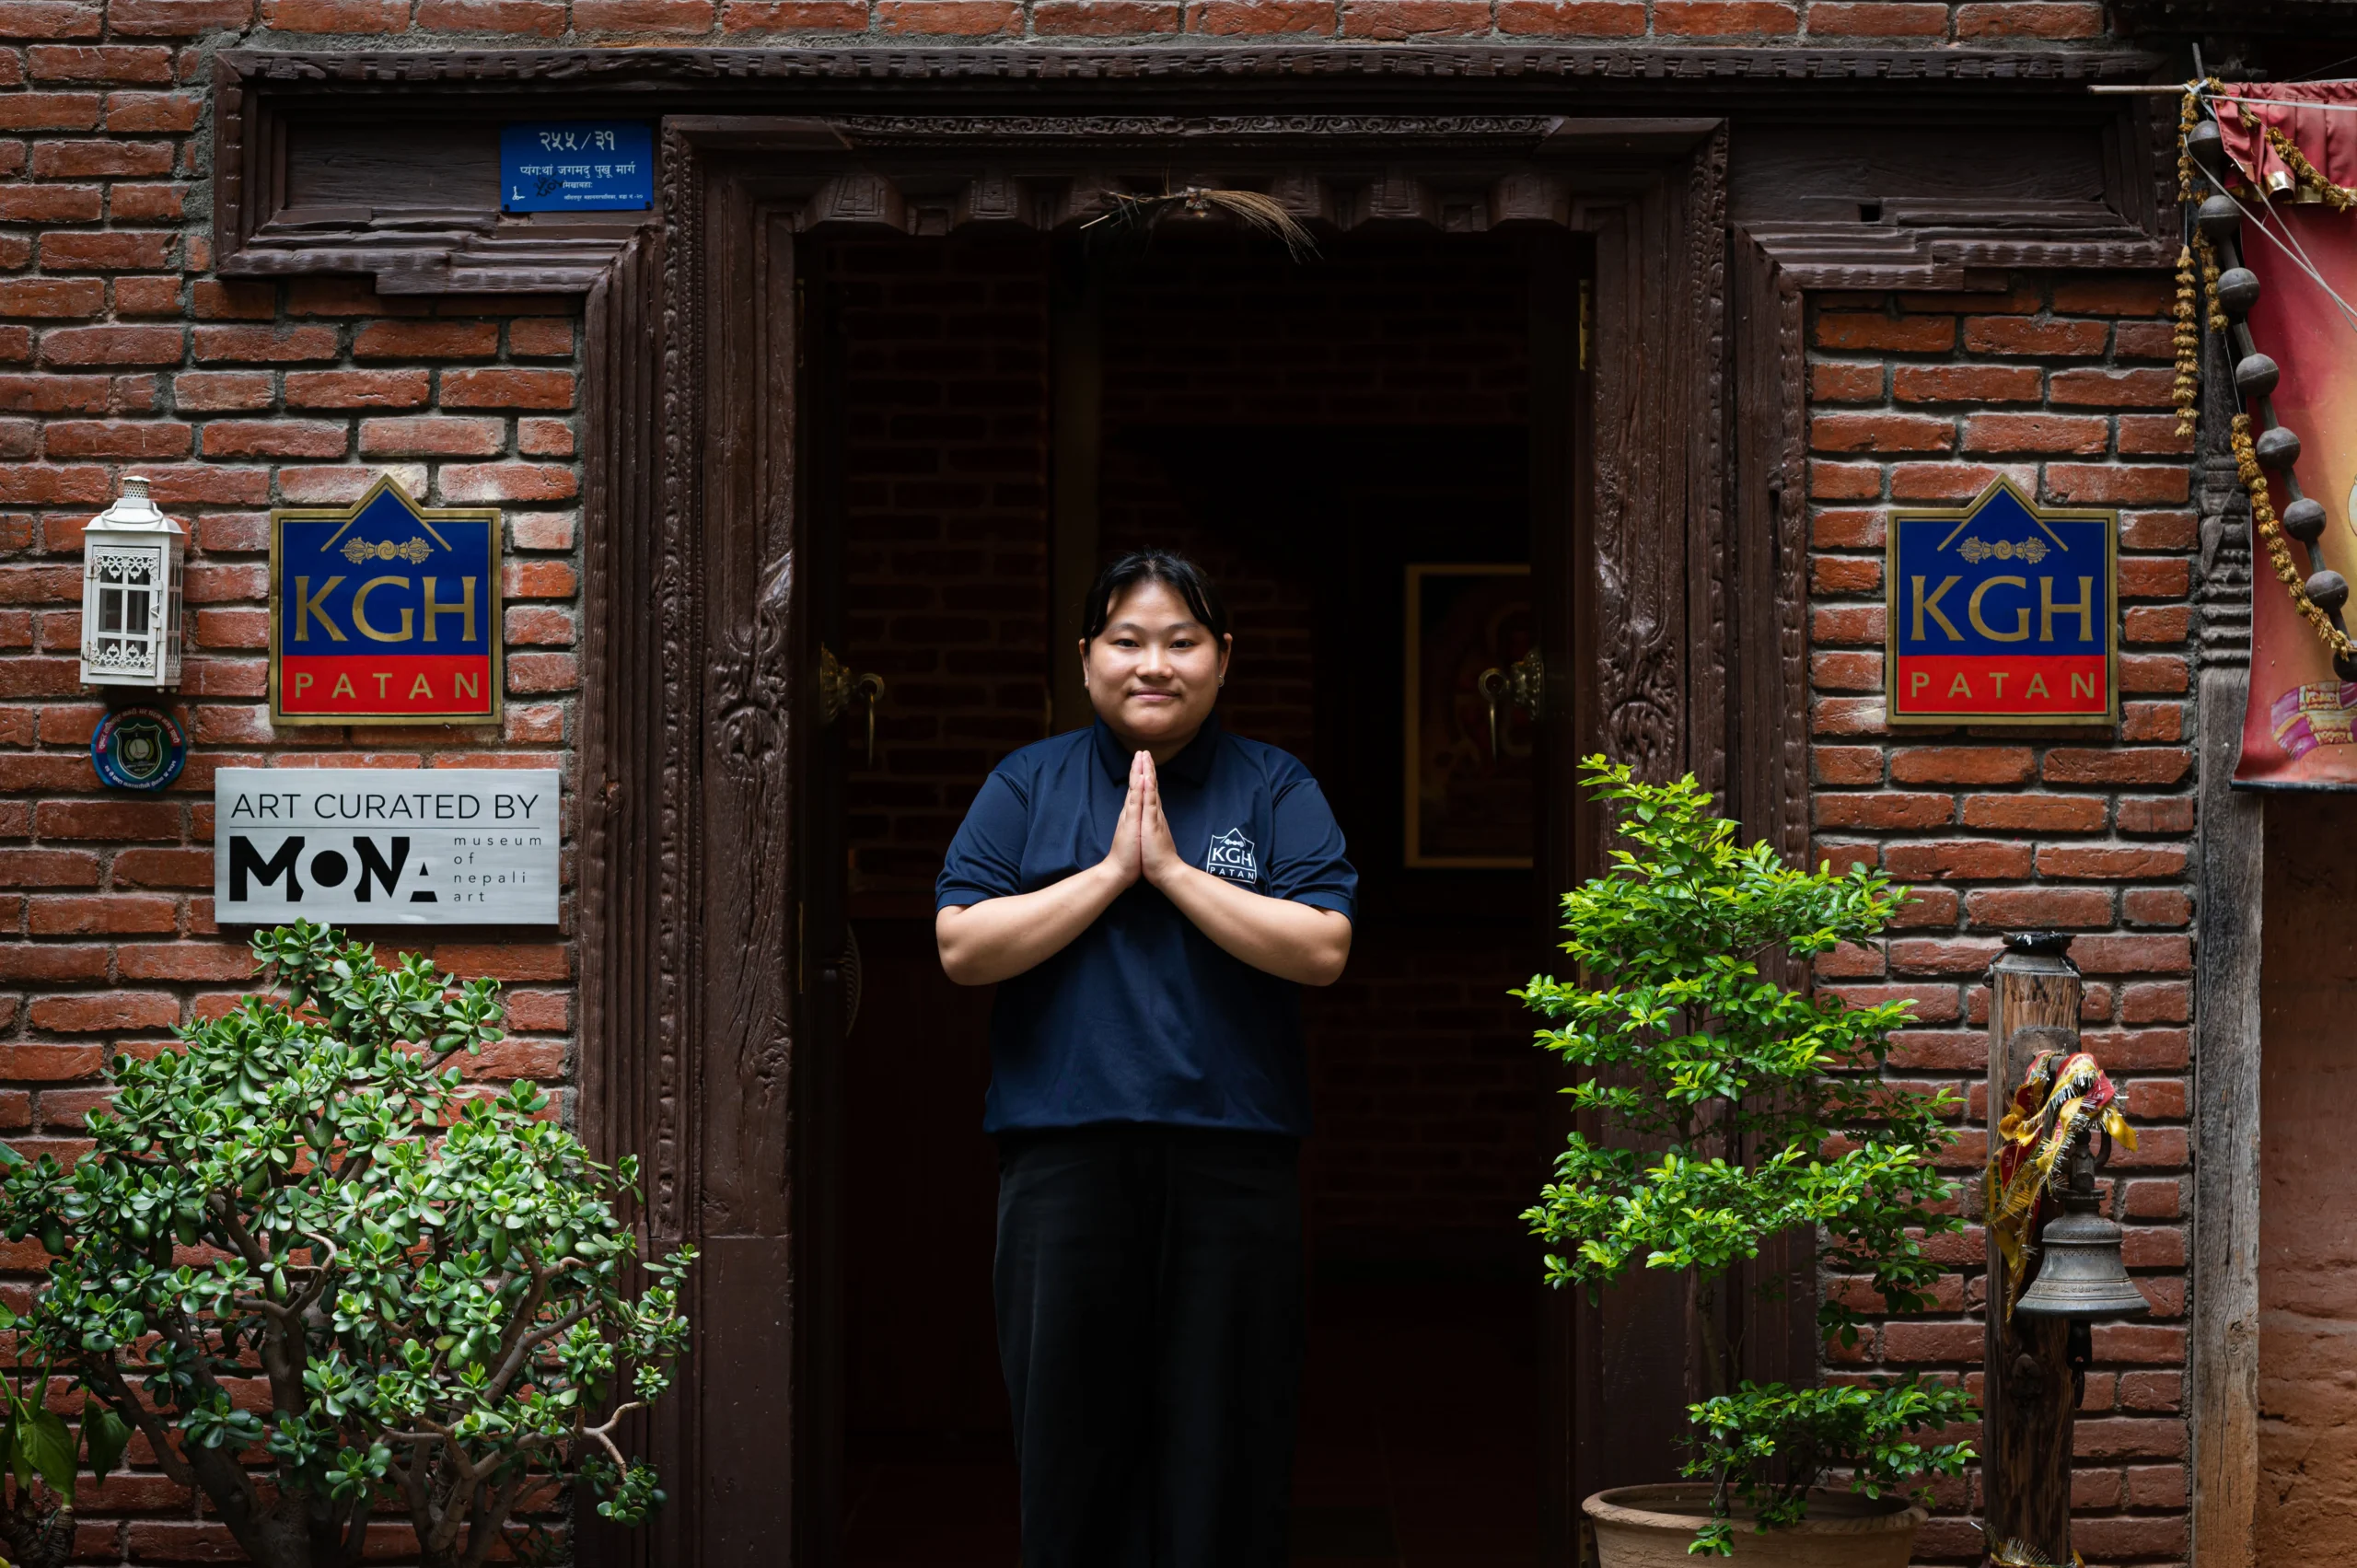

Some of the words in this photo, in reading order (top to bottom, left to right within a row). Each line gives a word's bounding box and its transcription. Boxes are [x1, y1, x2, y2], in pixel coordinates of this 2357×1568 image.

[615, 161, 636, 174] मार्ग
[295, 575, 477, 642] KGH
[1910, 575, 2094, 642] KGH
[295, 672, 479, 699] PATAN
[1911, 672, 2095, 699] PATAN
[231, 794, 302, 819] ART
[314, 794, 481, 819] CURATED
[495, 794, 539, 819] BY
[454, 837, 542, 846] museum
[454, 853, 474, 864] of
[1212, 847, 1252, 866] KGH
[454, 871, 526, 886] nepali
[1210, 867, 1254, 879] PATAN
[454, 892, 485, 902] art
